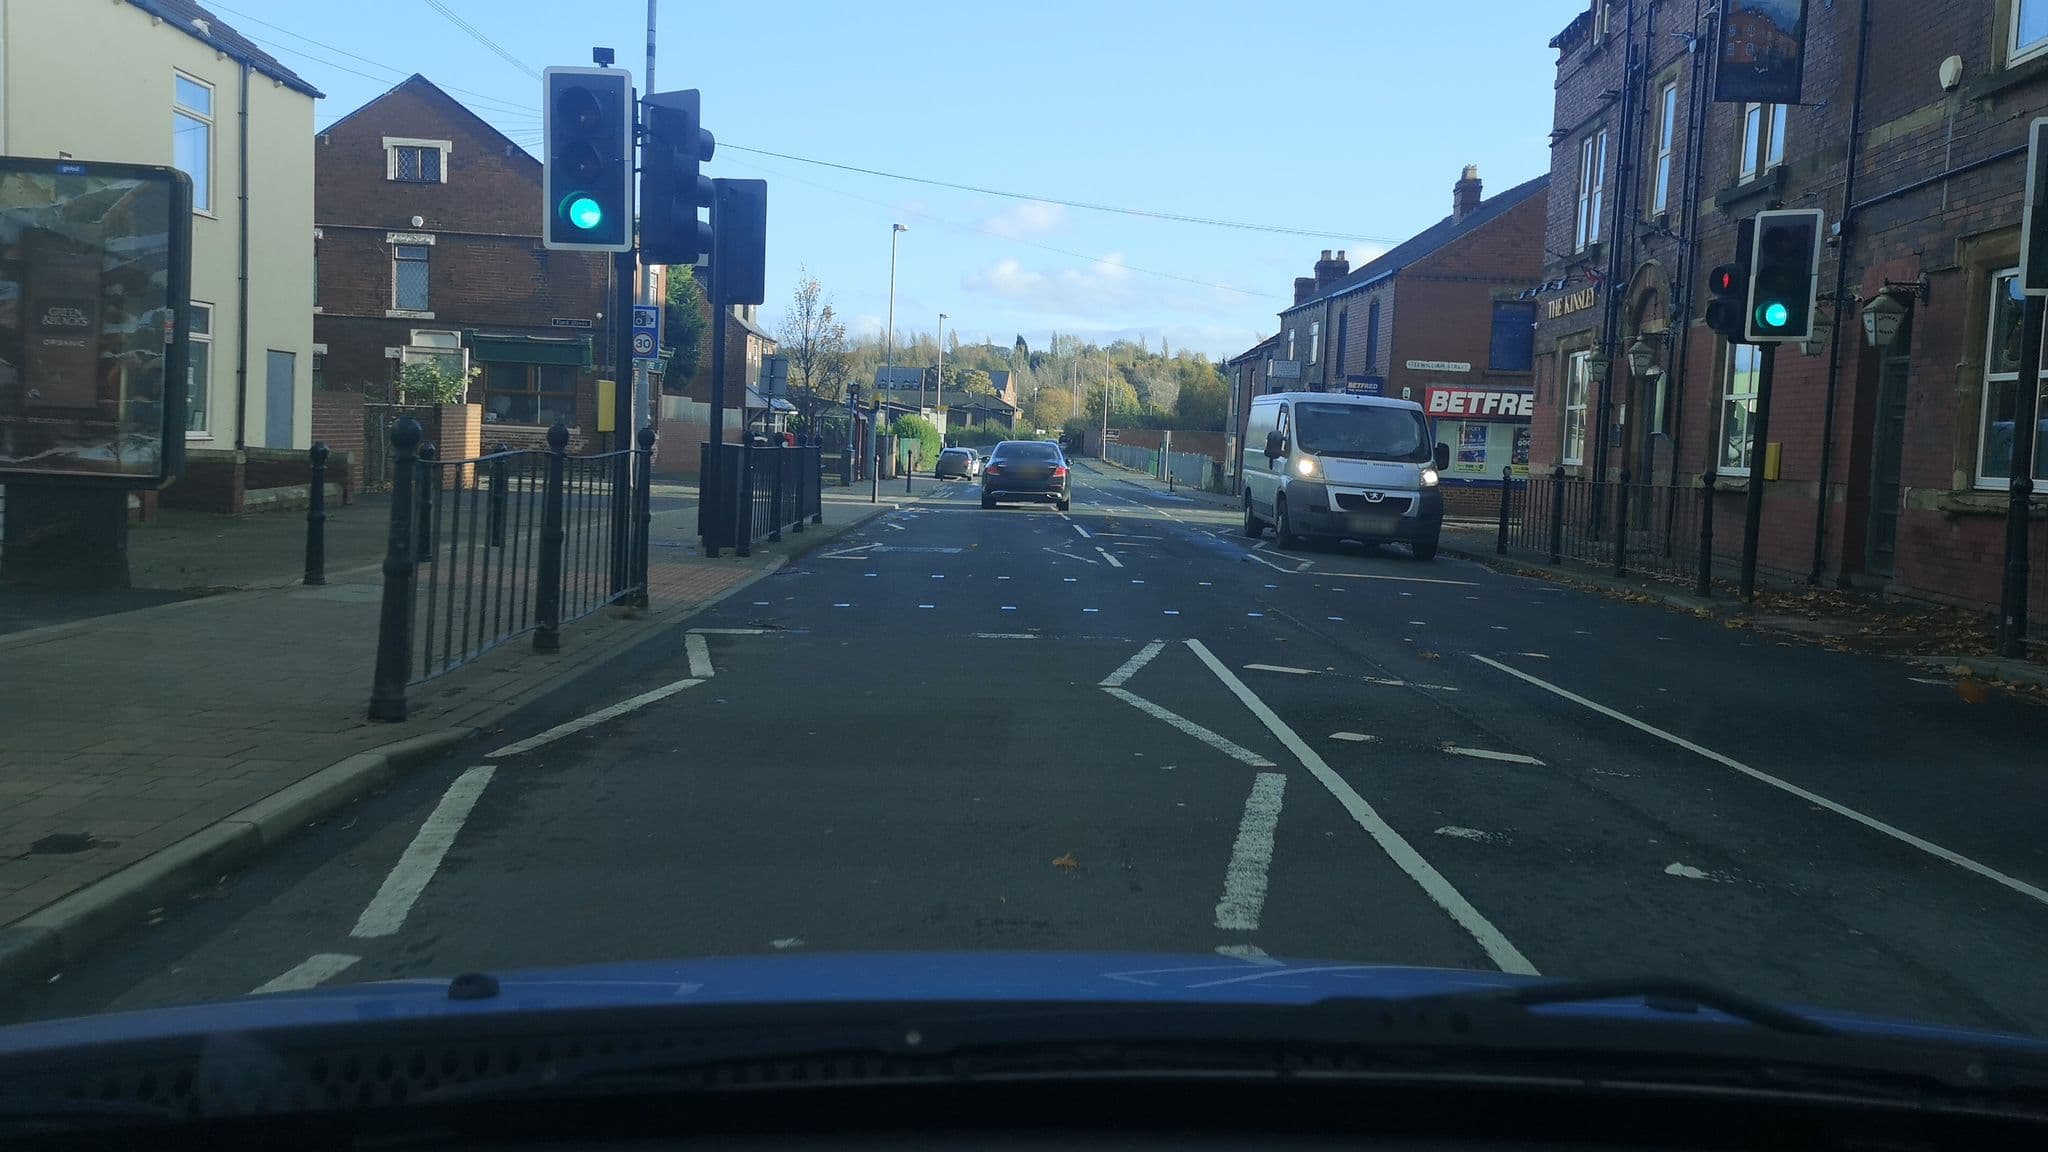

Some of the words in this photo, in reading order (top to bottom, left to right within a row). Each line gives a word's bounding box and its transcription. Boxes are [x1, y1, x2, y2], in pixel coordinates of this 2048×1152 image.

[1548, 298, 1562, 318] THE
[1564, 287, 1594, 314] KINSLEY
[635, 338, 650, 347] 30
